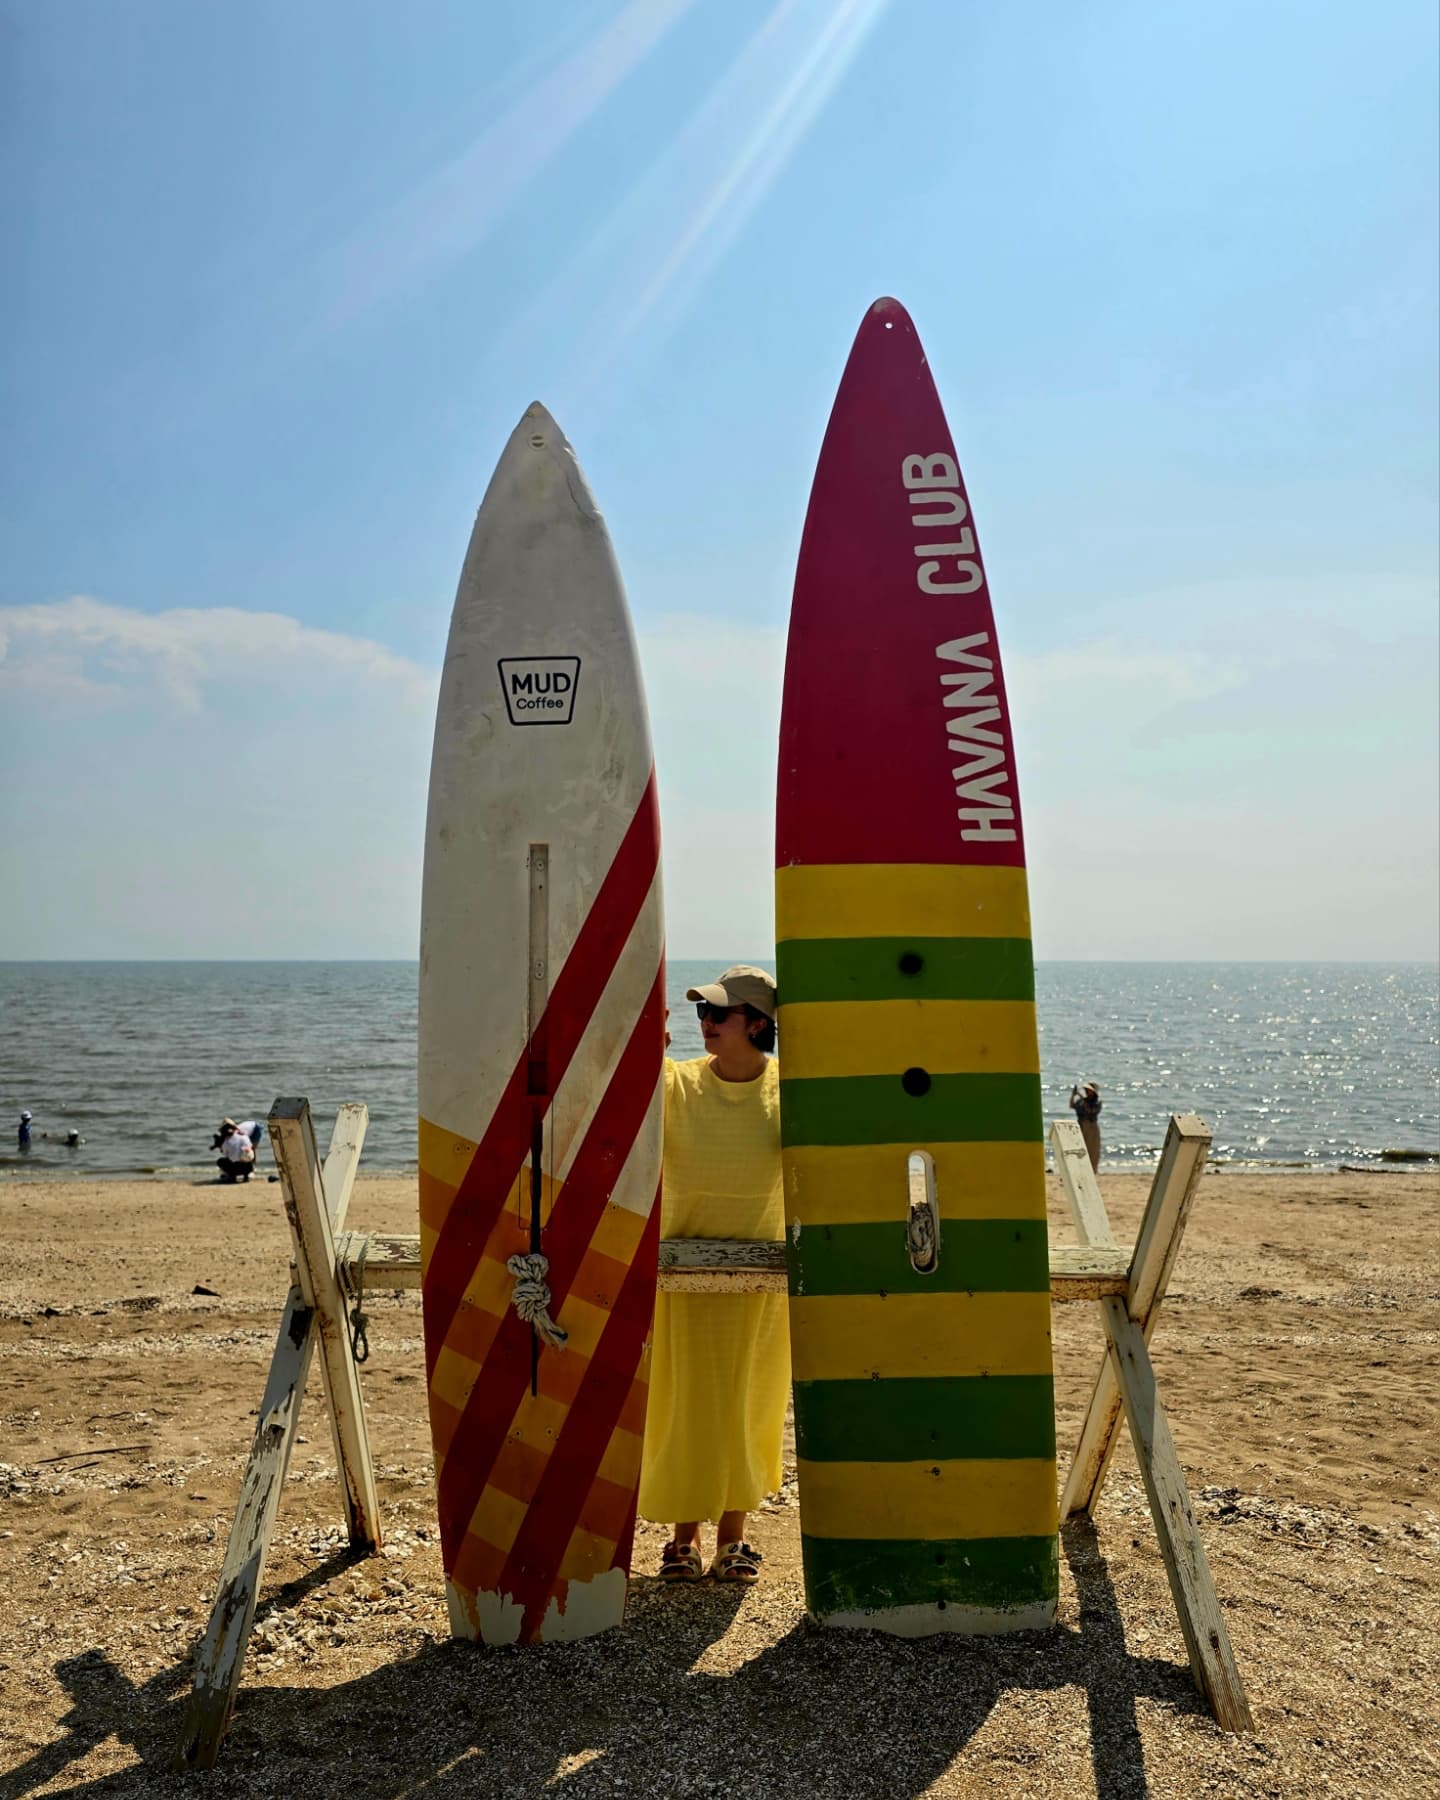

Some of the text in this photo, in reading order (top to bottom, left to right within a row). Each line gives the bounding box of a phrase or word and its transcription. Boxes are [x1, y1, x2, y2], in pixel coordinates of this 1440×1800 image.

[902, 453, 1017, 842] HAVANA CLUB
[511, 672, 571, 695] MUD
[516, 696, 564, 710] Coffee
